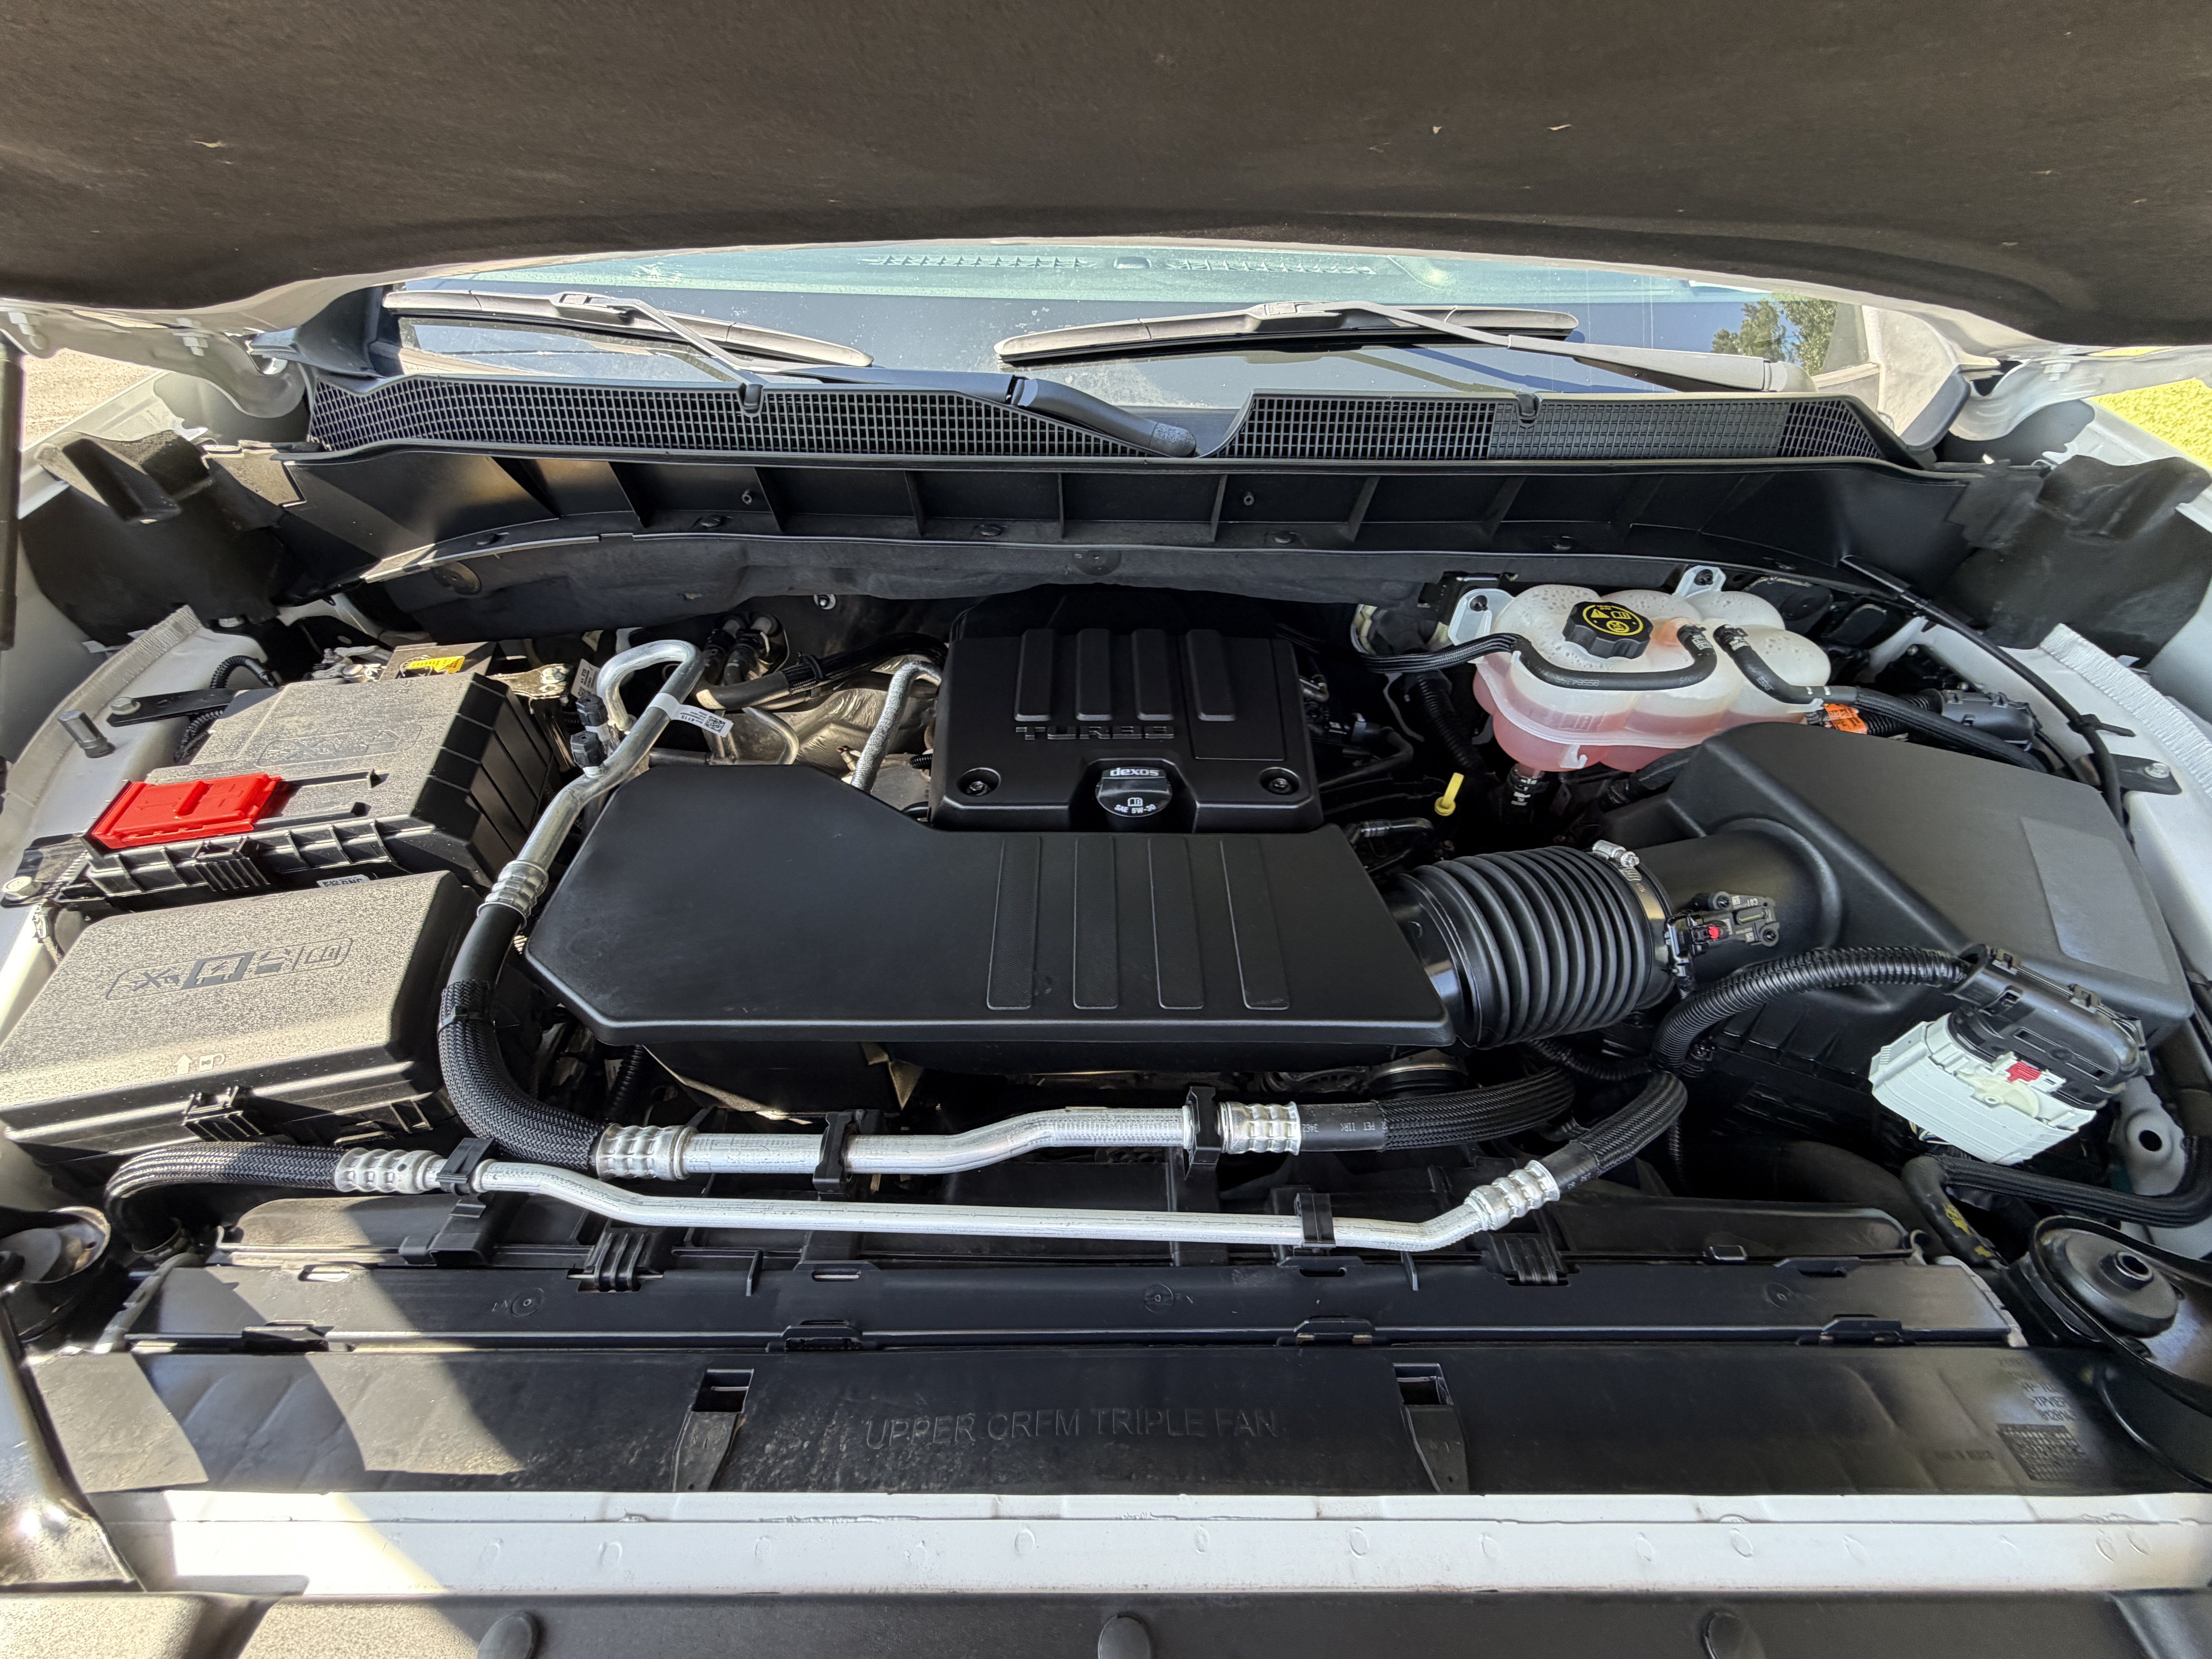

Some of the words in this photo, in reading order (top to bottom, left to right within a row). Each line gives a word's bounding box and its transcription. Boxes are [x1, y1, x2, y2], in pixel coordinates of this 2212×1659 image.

[1110, 767, 1161, 776] dexos
[1114, 804, 1129, 813] SAE
[1131, 804, 1156, 814] 5W-30
[1363, 1121, 1376, 1131] PET
[866, 1413, 976, 1449] UPPER
[988, 1408, 1079, 1440] CRFM
[1090, 1407, 1206, 1437] TRIPLE
[1215, 1408, 1278, 1437] FAN
